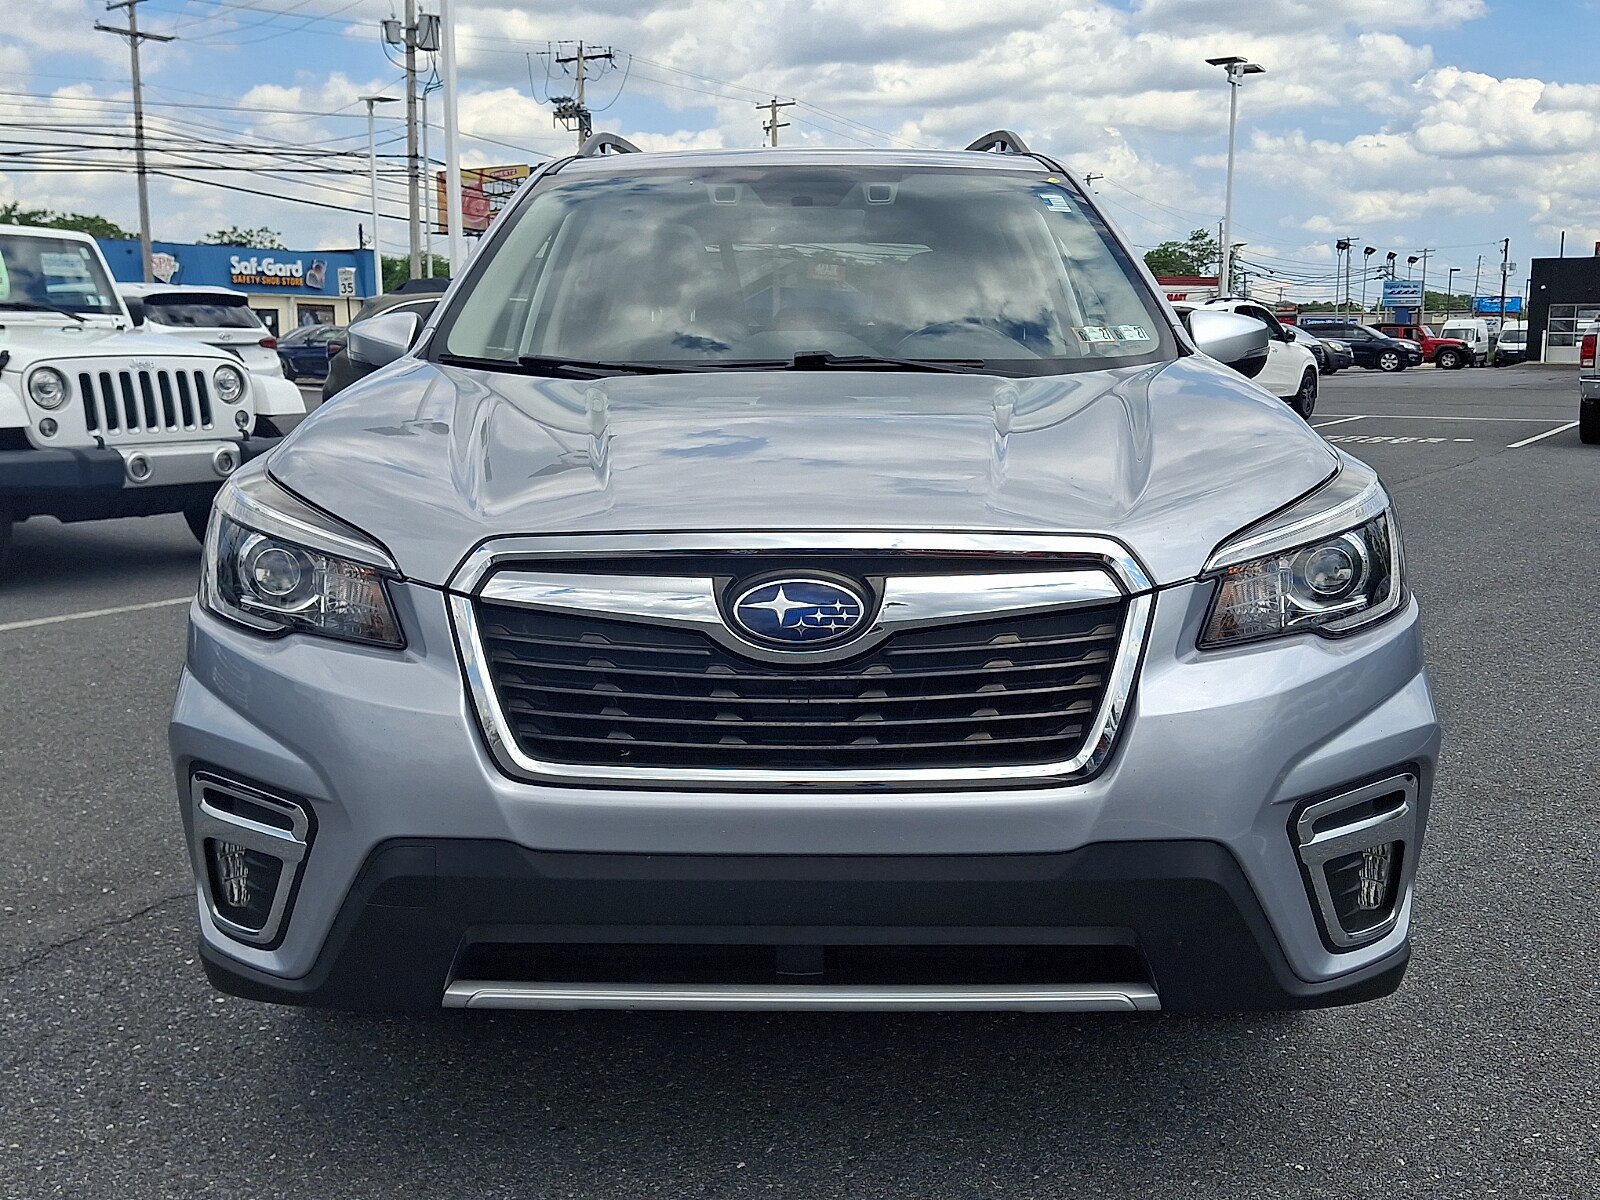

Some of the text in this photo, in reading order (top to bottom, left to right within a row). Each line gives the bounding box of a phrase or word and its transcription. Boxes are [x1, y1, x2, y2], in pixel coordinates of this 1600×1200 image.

[230, 255, 303, 277] Saf-Gard
[232, 275, 304, 286] SAFETY SHOE STORE
[341, 282, 354, 294] 35
